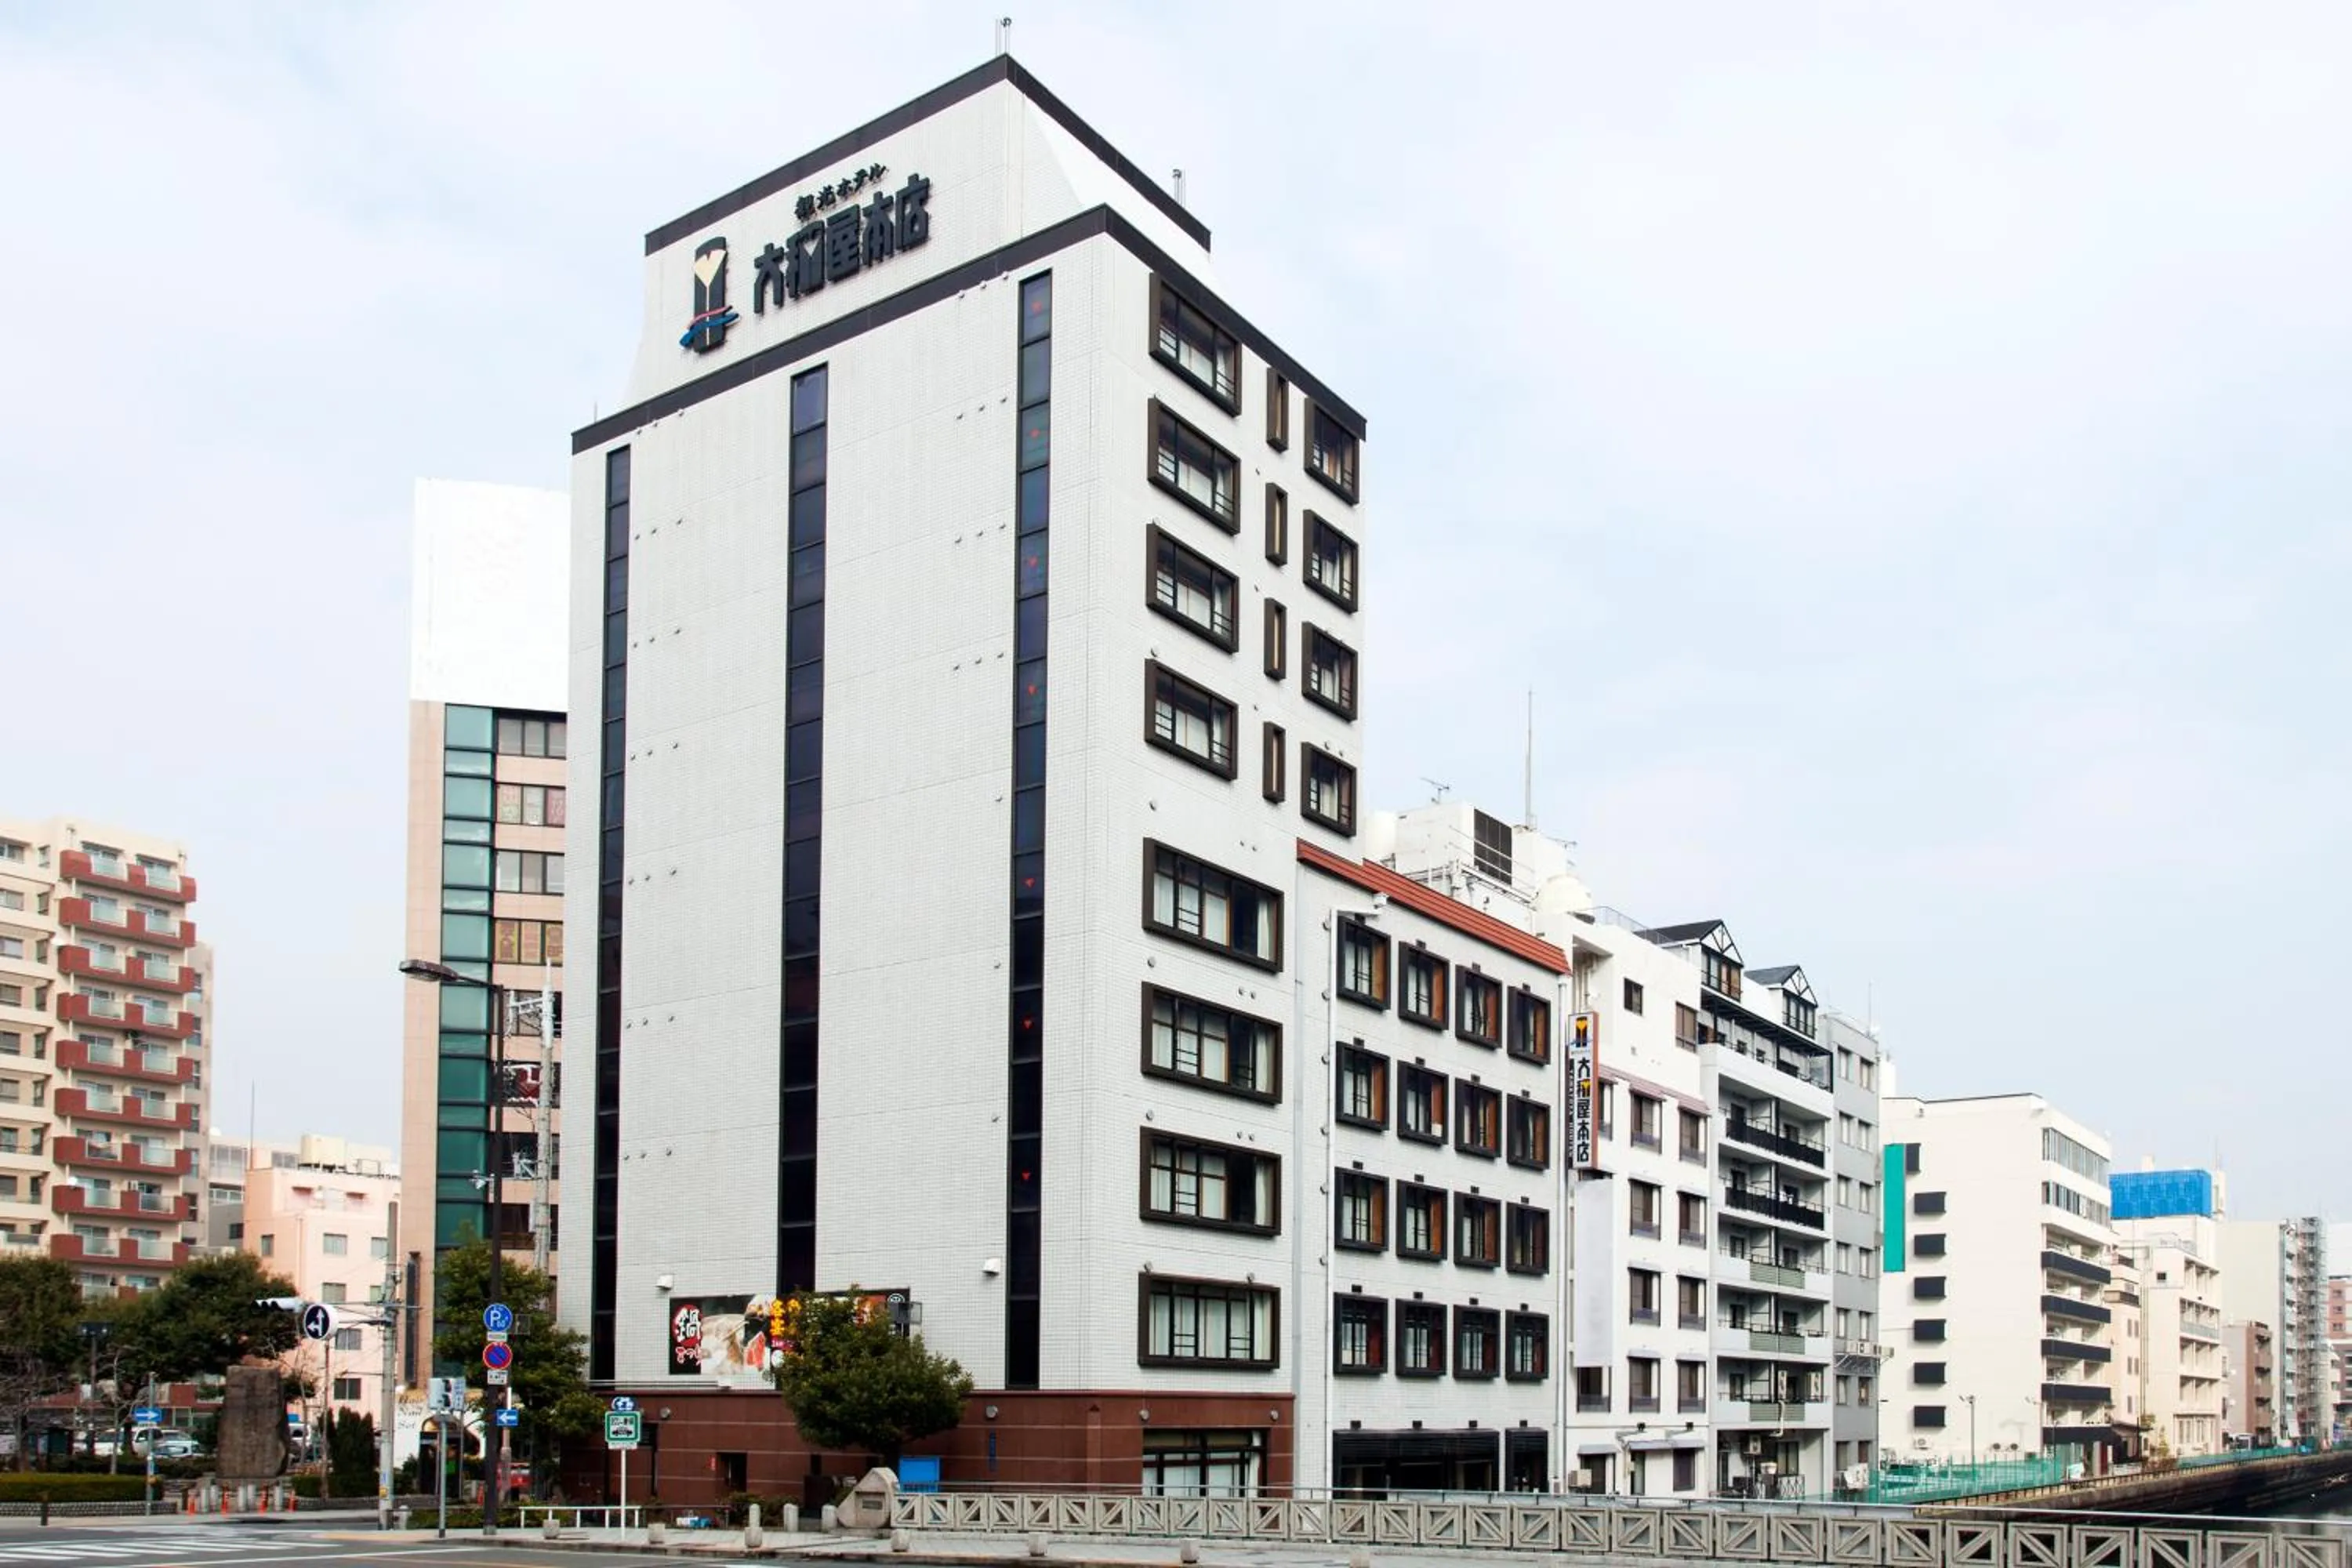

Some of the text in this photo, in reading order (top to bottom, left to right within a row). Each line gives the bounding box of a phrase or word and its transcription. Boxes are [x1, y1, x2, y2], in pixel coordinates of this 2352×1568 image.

[754, 173, 931, 314] 大和屋本店
[1577, 1057, 1592, 1162] 大和屋本店
[490, 1310, 501, 1327] P
[673, 1307, 702, 1343] 鍋
